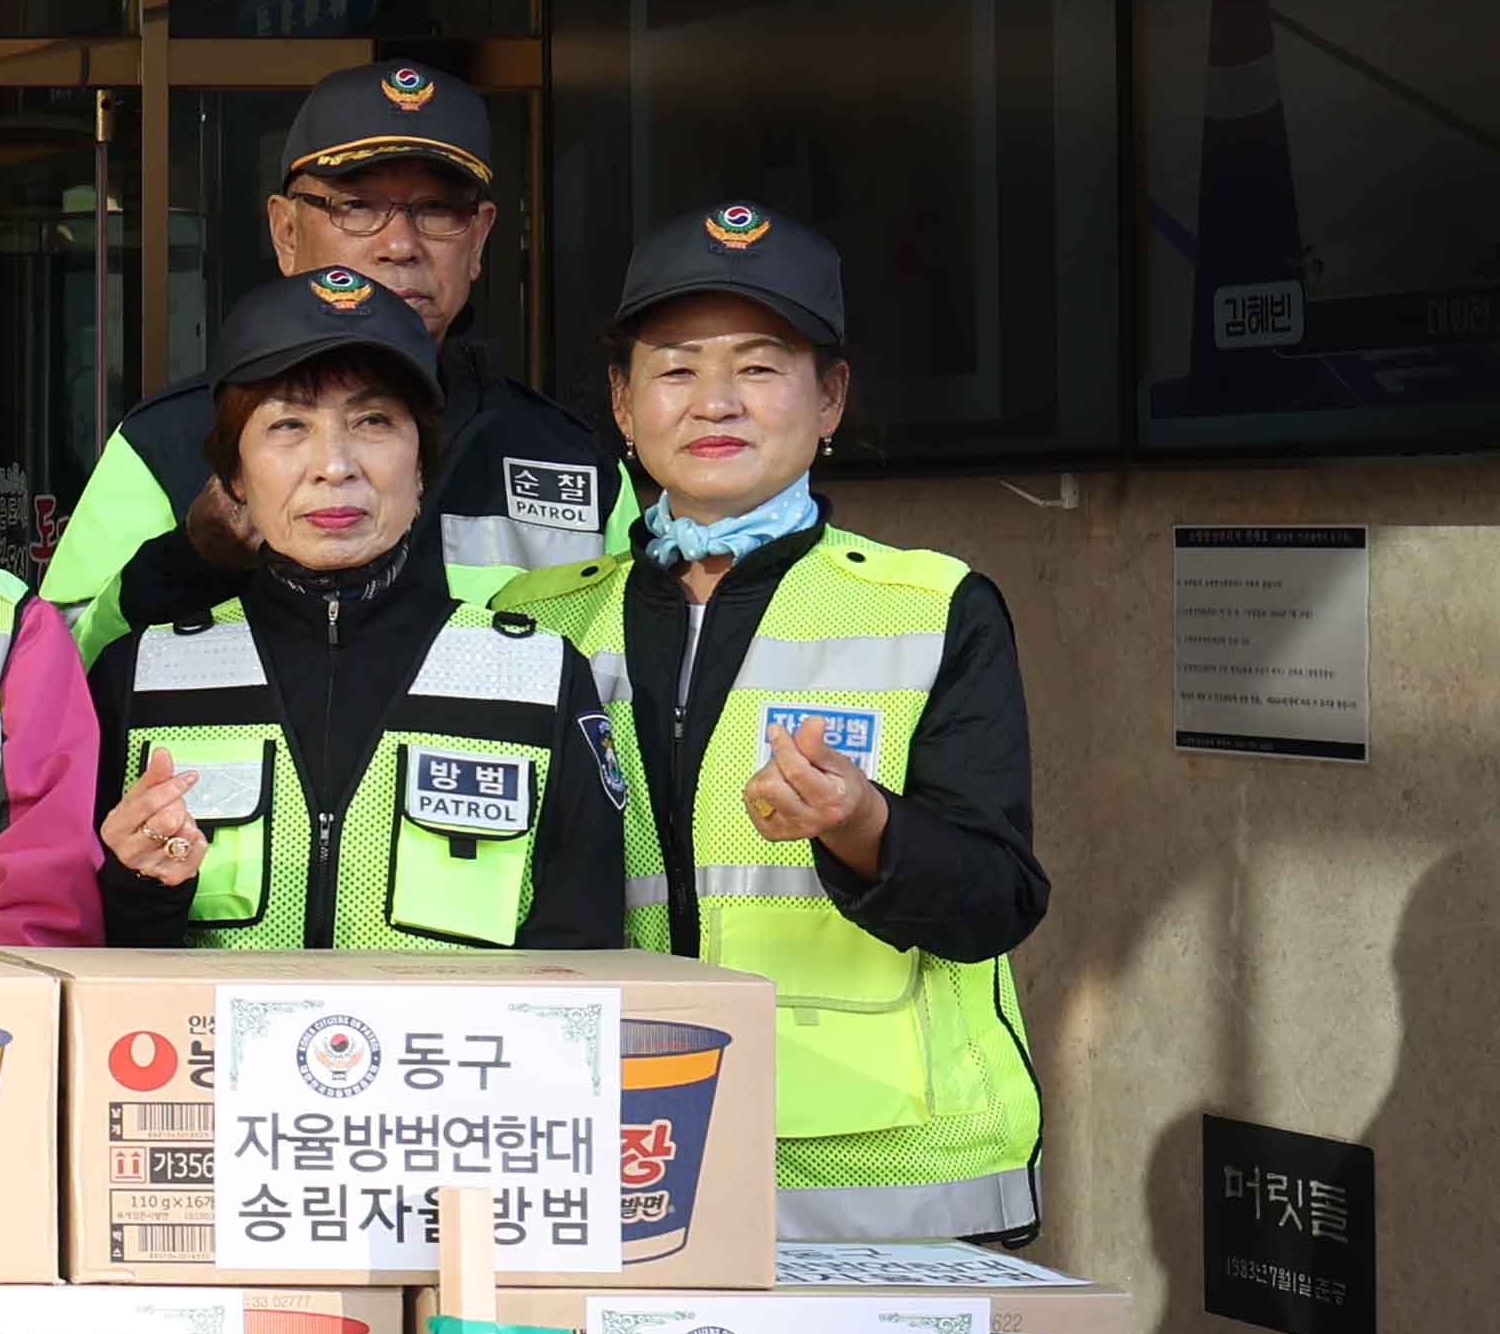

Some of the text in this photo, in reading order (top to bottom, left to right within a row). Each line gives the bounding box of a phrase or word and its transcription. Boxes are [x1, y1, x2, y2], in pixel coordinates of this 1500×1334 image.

[516, 502, 586, 523] PATROL
[419, 795, 516, 822] PATROL
[397, 1032, 512, 1092] 동구
[233, 1113, 594, 1175] 자율방범연합대
[1222, 1165, 1349, 1244] 머릿돌
